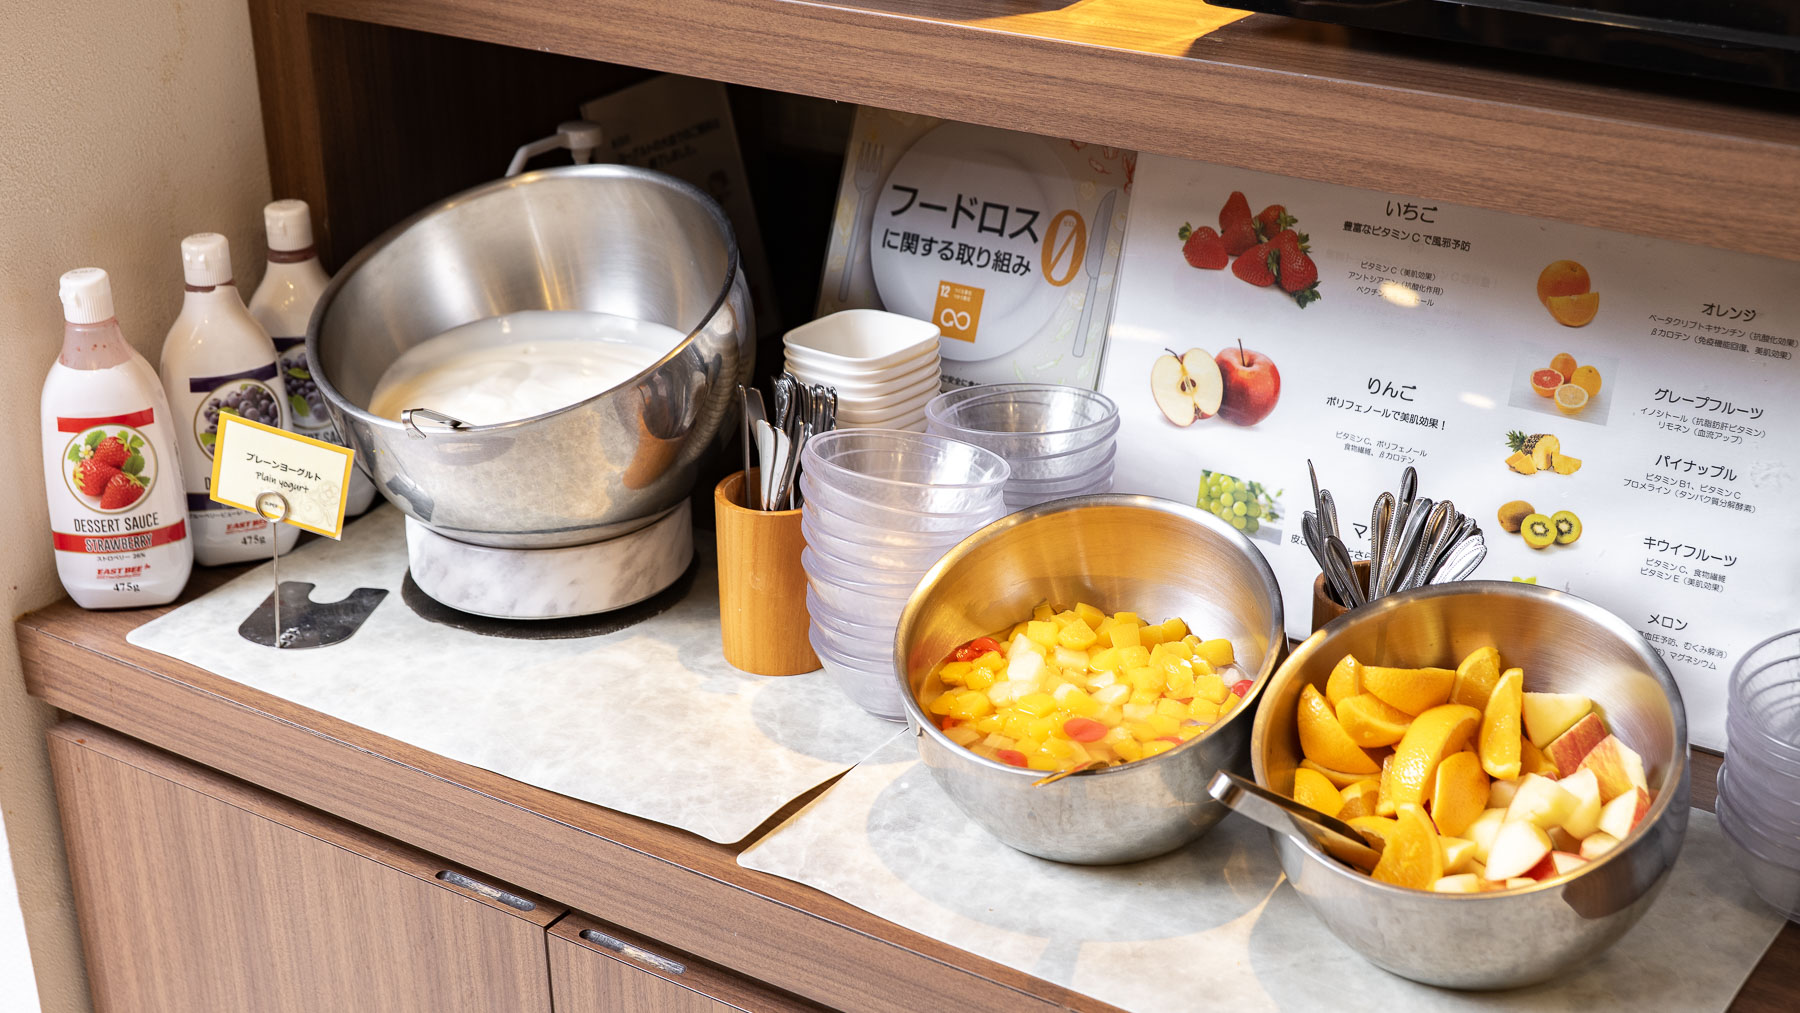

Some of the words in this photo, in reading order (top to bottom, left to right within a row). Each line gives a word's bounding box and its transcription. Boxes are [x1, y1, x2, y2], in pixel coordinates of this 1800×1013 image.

[891, 184, 1040, 244] フードロス
[1386, 200, 1438, 223] いちご
[882, 228, 1031, 276] に関する取り組み
[940, 284, 951, 298] 12
[1701, 302, 1757, 322] オレンジ
[1367, 377, 1417, 402] りんご
[1654, 388, 1764, 420] グレープフルーツ
[1655, 454, 1738, 482] パイナップル
[255, 471, 277, 485] Plain
[278, 480, 310, 494] yogurt
[74, 518, 121, 533] DESSERT
[125, 512, 159, 531] SAUCE
[85, 533, 153, 553] STRAWBERRY
[241, 534, 267, 546] 475g
[1643, 536, 1738, 567] キウイフルーツ
[97, 568, 122, 576] EAST
[113, 582, 140, 592] 475g
[1648, 614, 1688, 631] メロン
